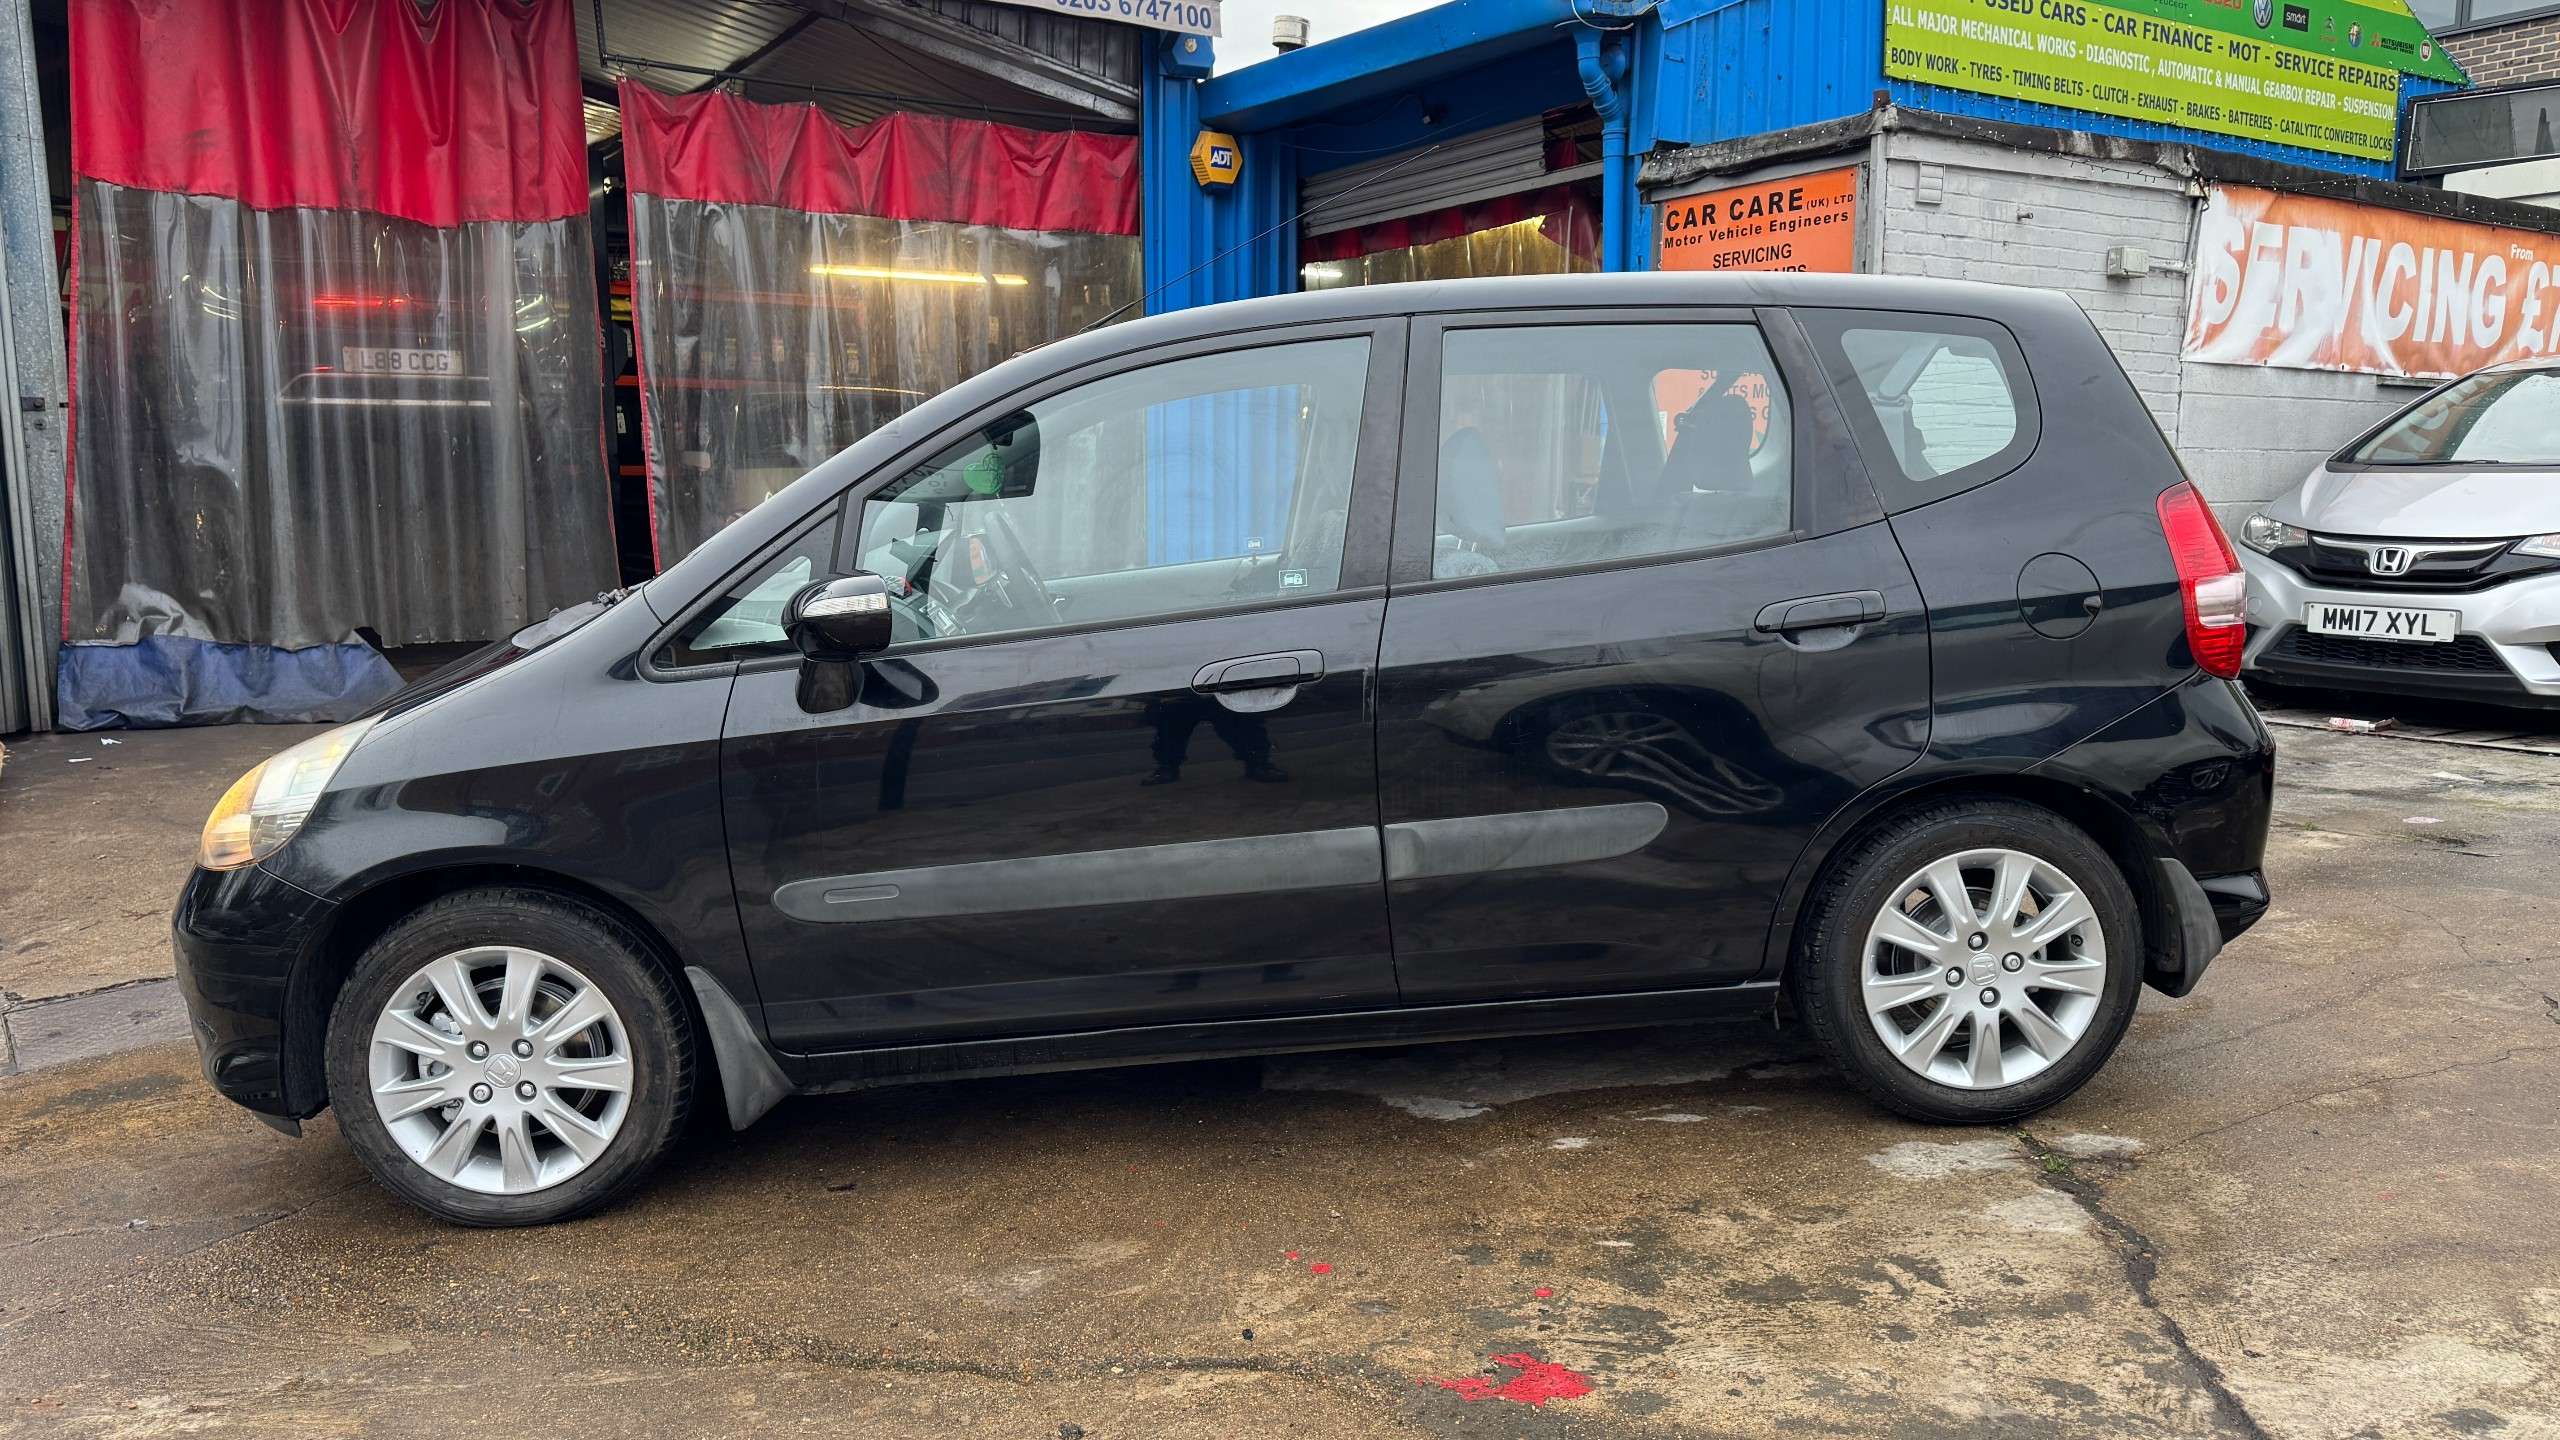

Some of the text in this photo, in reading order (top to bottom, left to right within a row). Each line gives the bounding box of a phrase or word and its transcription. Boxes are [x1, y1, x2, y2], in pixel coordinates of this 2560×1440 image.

[1119, 0, 1212, 29] 6747100
[2286, 11, 2307, 25] smart
[2040, 0, 2086, 26] CARS
[2104, 13, 2137, 37] CAR
[2143, 21, 2214, 53] FINANCE
[2229, 40, 2262, 63] MOT
[2275, 50, 2335, 79] SERVICE
[2339, 64, 2396, 92] REPAIRS
[1892, 5, 1914, 28] ALL
[1918, 9, 1958, 36] MAJOR
[1961, 18, 2035, 51] MECHANICAL
[2036, 33, 2077, 59] WORKS
[2086, 43, 2150, 73] DIAGNOSTIC
[2158, 58, 2213, 86] AUTOMATIC
[2225, 72, 2261, 97] MANUAL
[2264, 79, 2304, 103] GEARBOX
[2305, 88, 2336, 110] REPAIR
[2343, 96, 2394, 121] SUSPENSION
[1891, 47, 2393, 152] BODY WORK TYRES TIMING BELTS CLUTCH EXHAUST BRAKES BATTERIES CATALYTIC CONVERTER LOCKS
[1210, 149, 1232, 166] ADT
[1665, 187, 1854, 232] CAR CARE (UK) LTD
[1664, 211, 1849, 249] Motor Vehicle Engineers
[1712, 243, 1792, 269] SERVICING
[2510, 243, 2535, 261] From
[2198, 208, 2508, 349] SERVICING
[361, 351, 449, 371] L88 CCG
[2322, 607, 2437, 637] MM17 XYL
